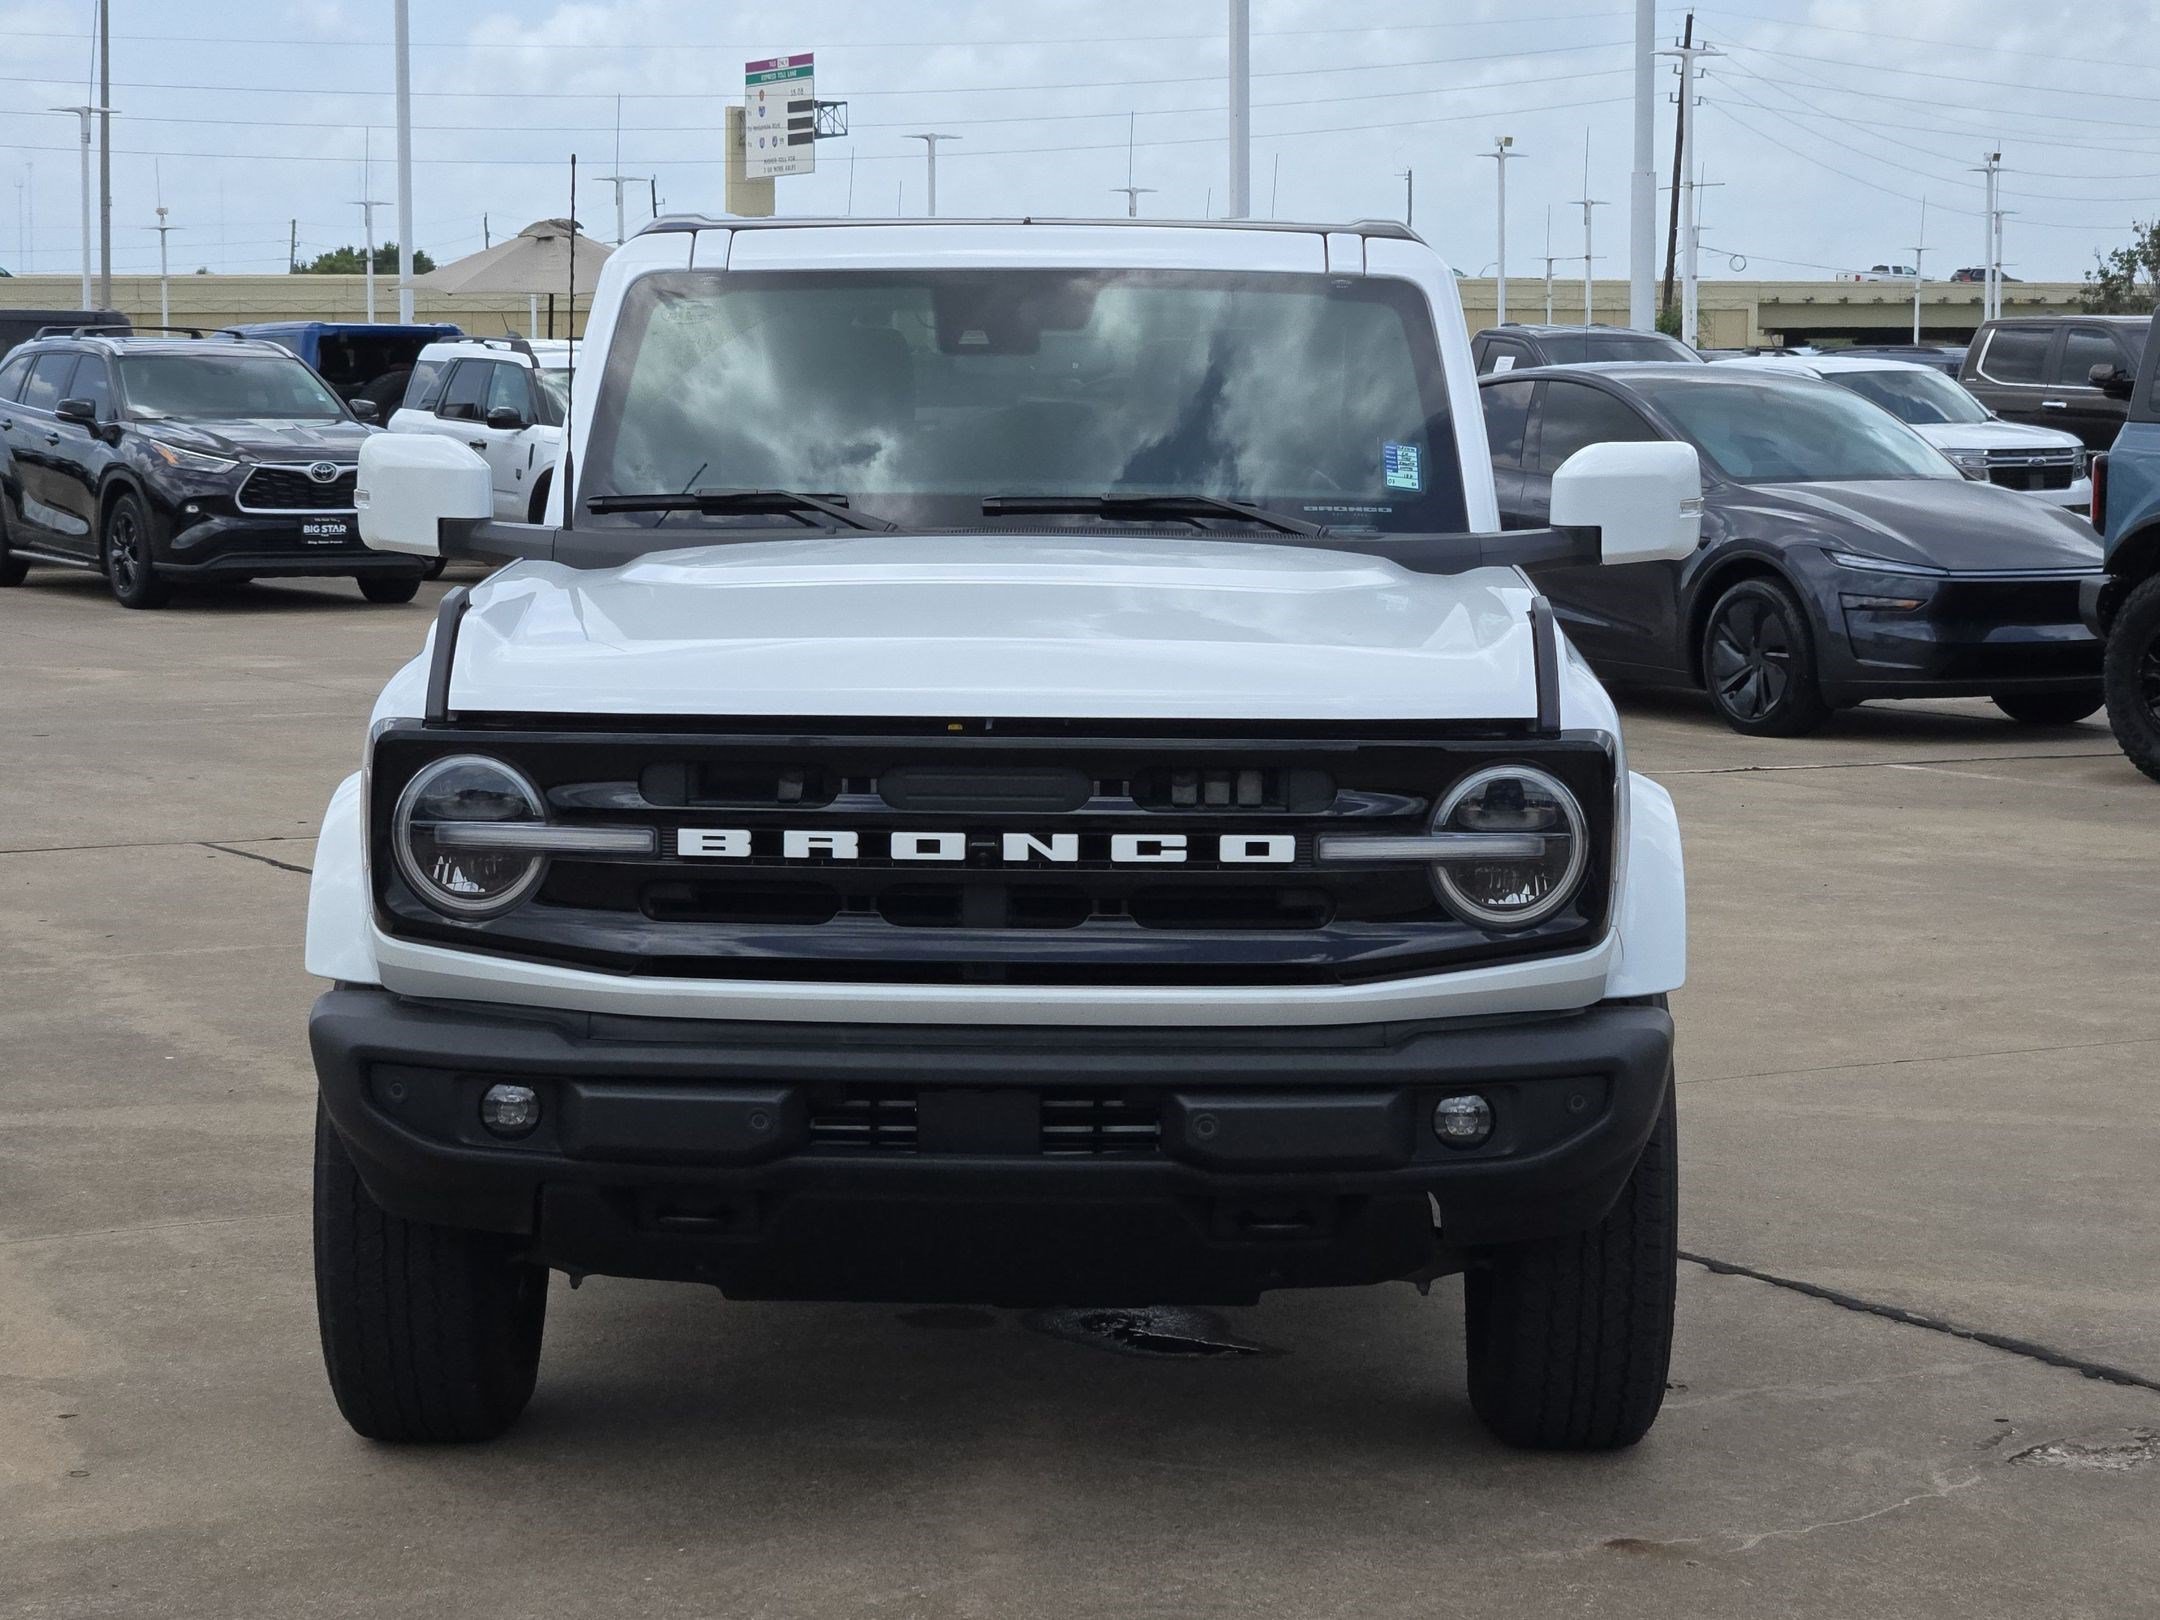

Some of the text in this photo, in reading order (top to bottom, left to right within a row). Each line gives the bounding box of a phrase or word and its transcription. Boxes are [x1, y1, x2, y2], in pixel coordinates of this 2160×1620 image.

[303, 525, 347, 533] BIG STAR
[677, 829, 1296, 863] BRONCO
